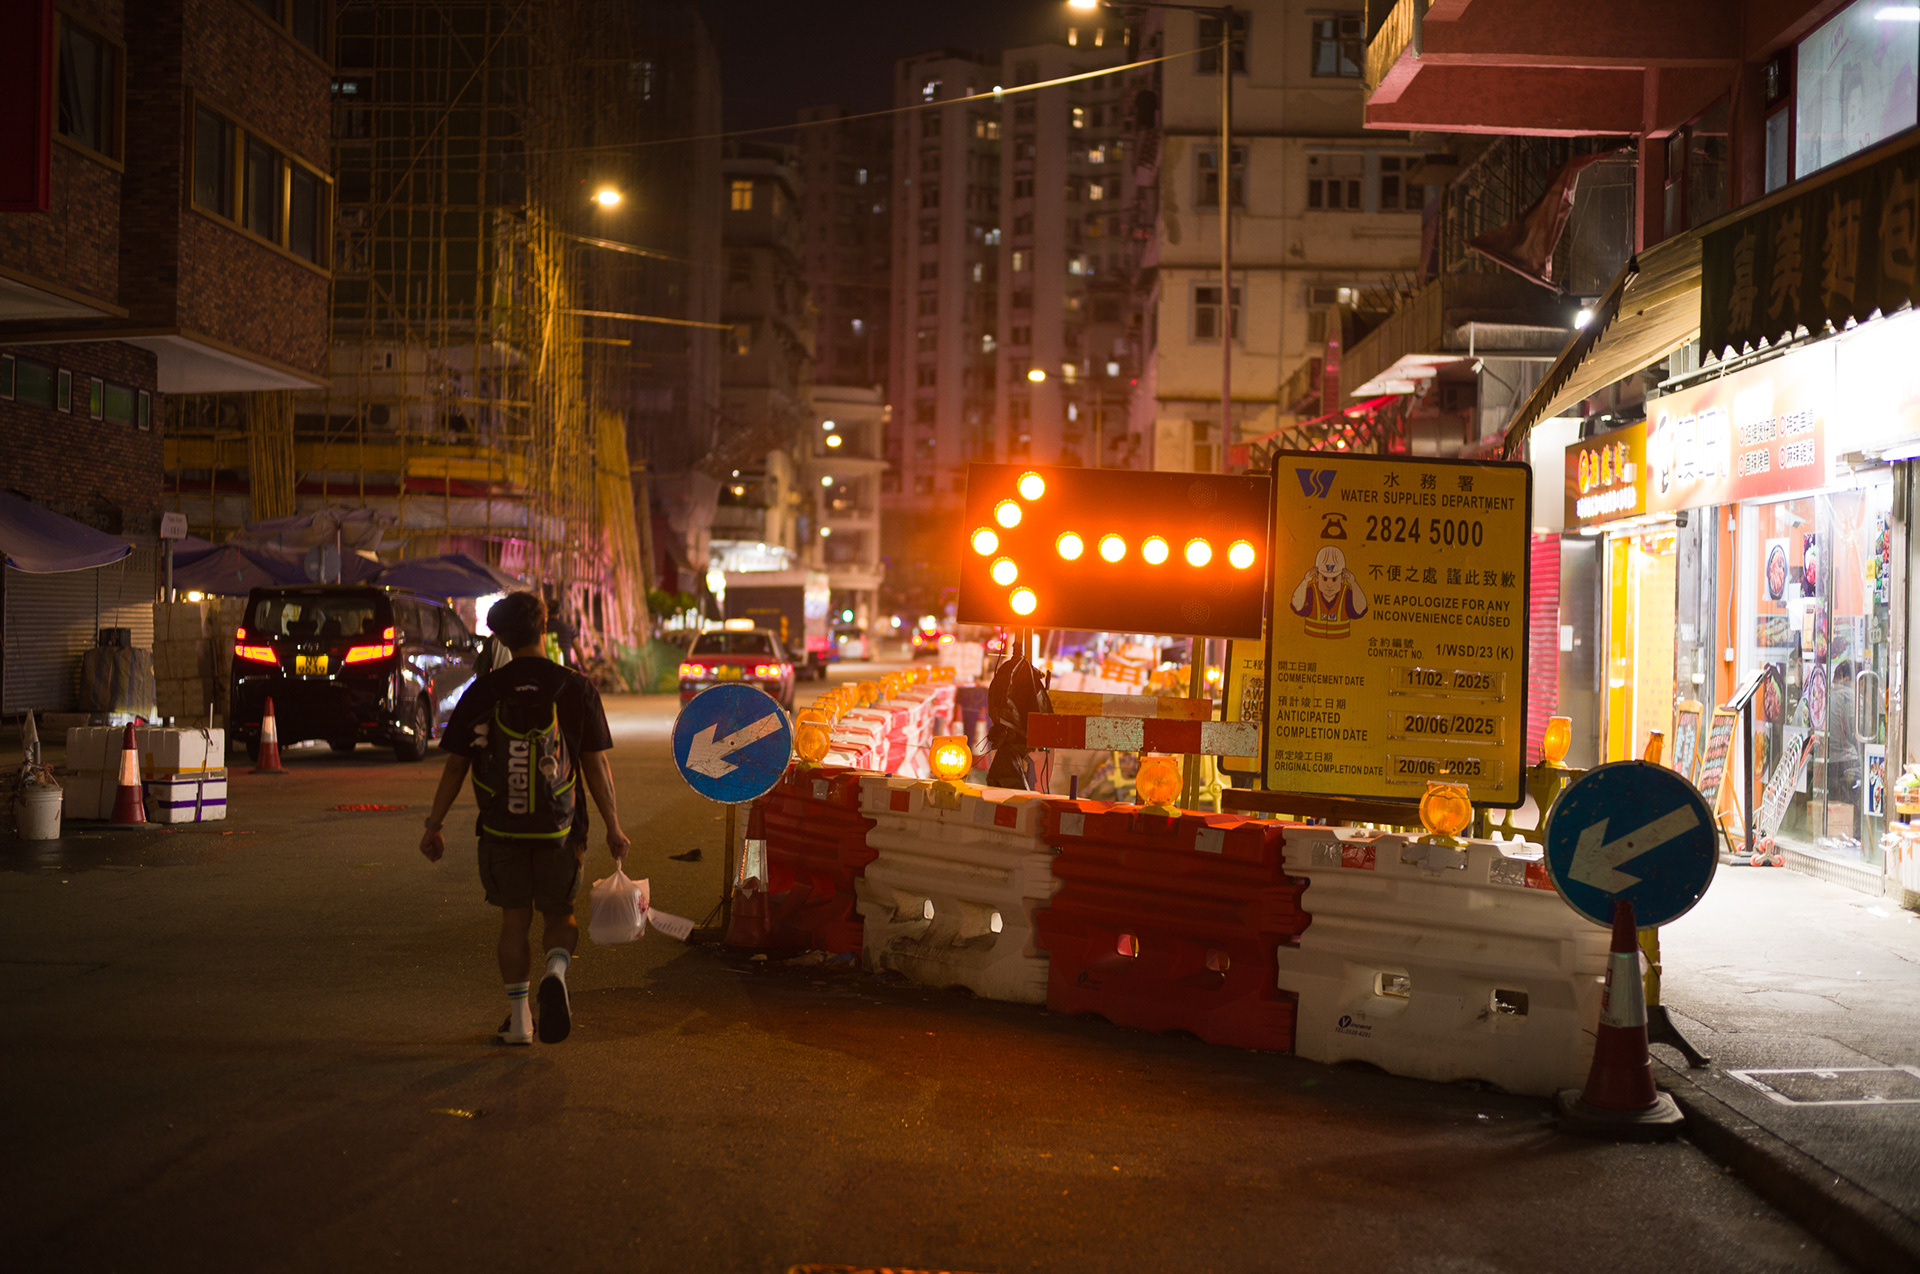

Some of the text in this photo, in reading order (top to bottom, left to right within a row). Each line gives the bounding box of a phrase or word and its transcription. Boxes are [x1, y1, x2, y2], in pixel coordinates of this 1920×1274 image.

[1383, 471, 1474, 492] 水務署
[1341, 488, 1515, 511] WATER SUPPLIES DEPARTMENT
[1366, 515, 1483, 547] 2824 5000
[1373, 594, 1511, 612] WE APOLOGIZE FOR ANY
[1373, 610, 1511, 628] INCONVENIENCE CAUSED
[1367, 636, 1414, 649] 合約編號
[1367, 647, 1424, 660] CONTRACT NO.
[1435, 643, 1514, 661] 1/WSD/23 (K)
[1277, 661, 1317, 673] 開工日期
[1277, 672, 1343, 685] COMMENCEMENT
[1345, 675, 1365, 686] DATE
[1407, 671, 1443, 687] 11/02
[1277, 696, 1346, 709] 預計竣工日期
[1276, 710, 1340, 724] ANTICIPATED
[1276, 726, 1368, 742] COMPLETION DATE
[1274, 750, 1333, 763] 原定竣工日期
[1274, 761, 1383, 776] ORIGINAL COMPLETION DATE
[1399, 759, 1435, 775] 20/06
[508, 740, 530, 814] arena
